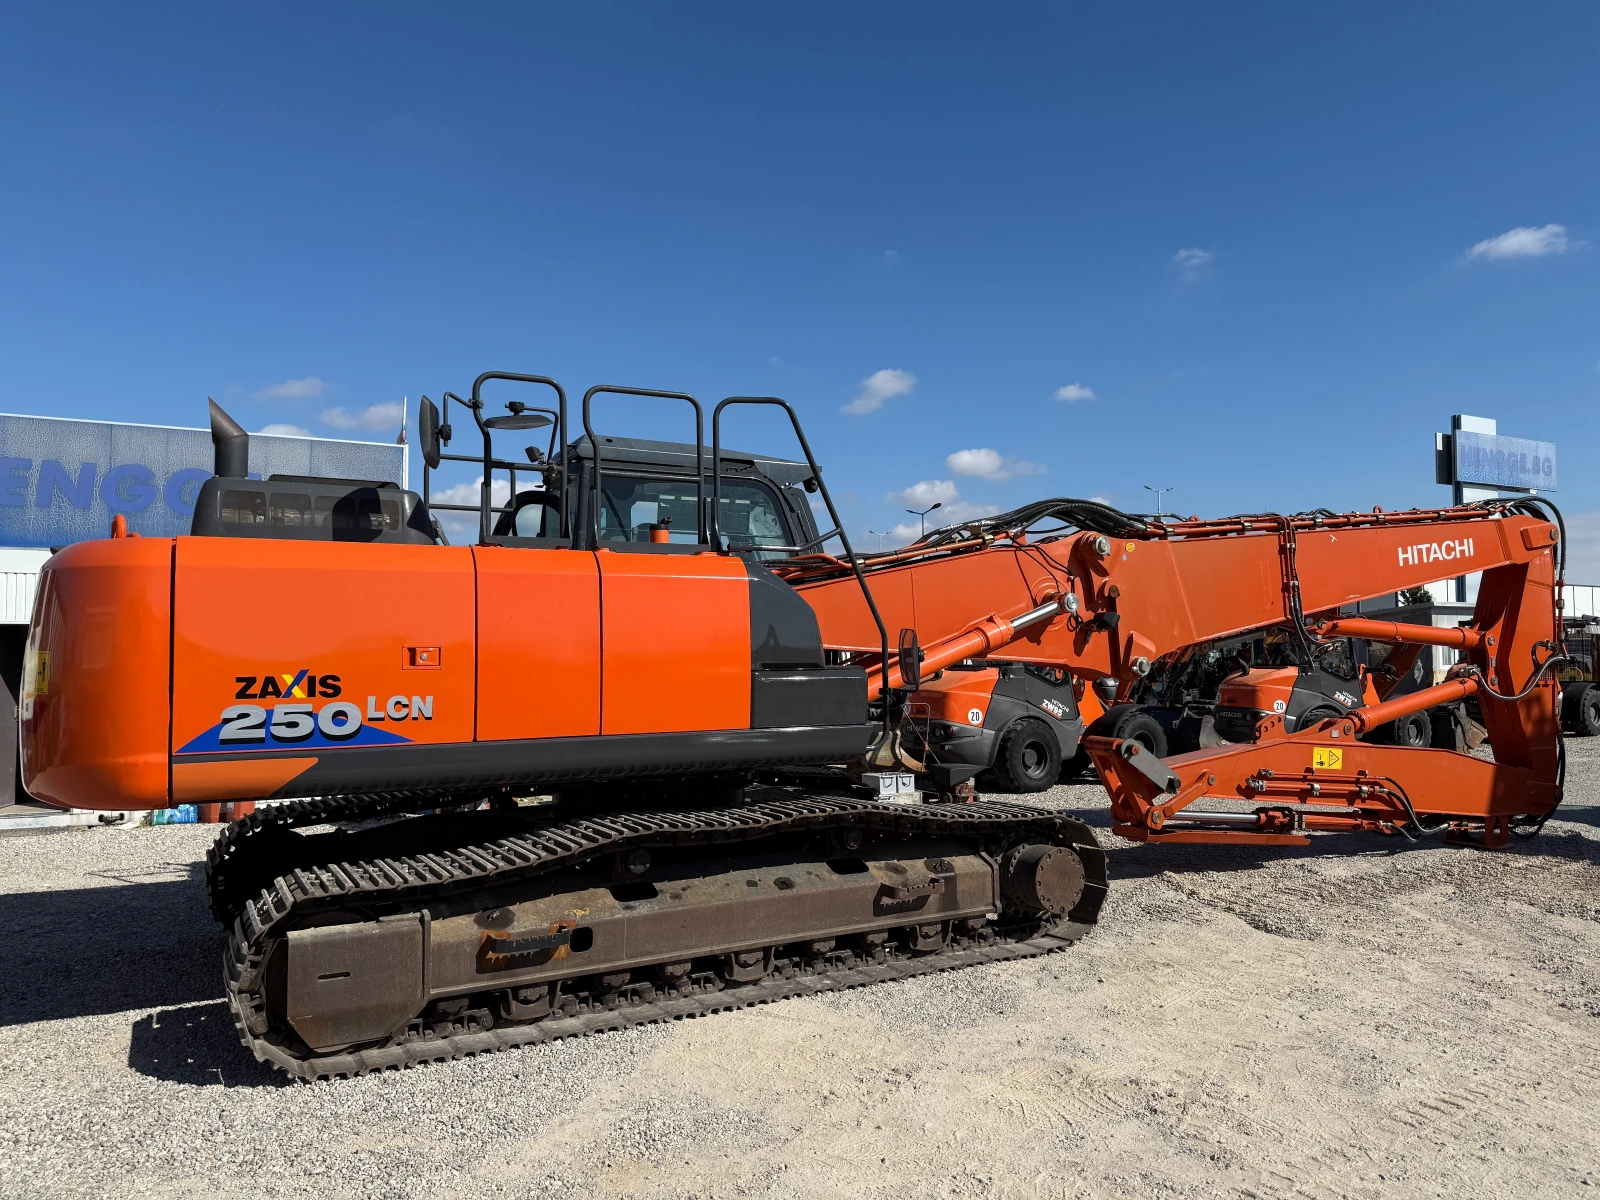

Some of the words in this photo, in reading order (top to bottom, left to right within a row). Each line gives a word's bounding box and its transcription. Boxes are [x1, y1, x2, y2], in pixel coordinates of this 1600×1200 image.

[1398, 538, 1474, 566] HITACHI
[235, 668, 342, 699] ZAXIS
[1042, 698, 1063, 717] ZW95
[1051, 698, 1070, 713] HITACHI
[1275, 702, 1284, 711] 20
[218, 701, 362, 745] 250
[367, 695, 434, 722] LCN
[970, 711, 980, 722] 20
